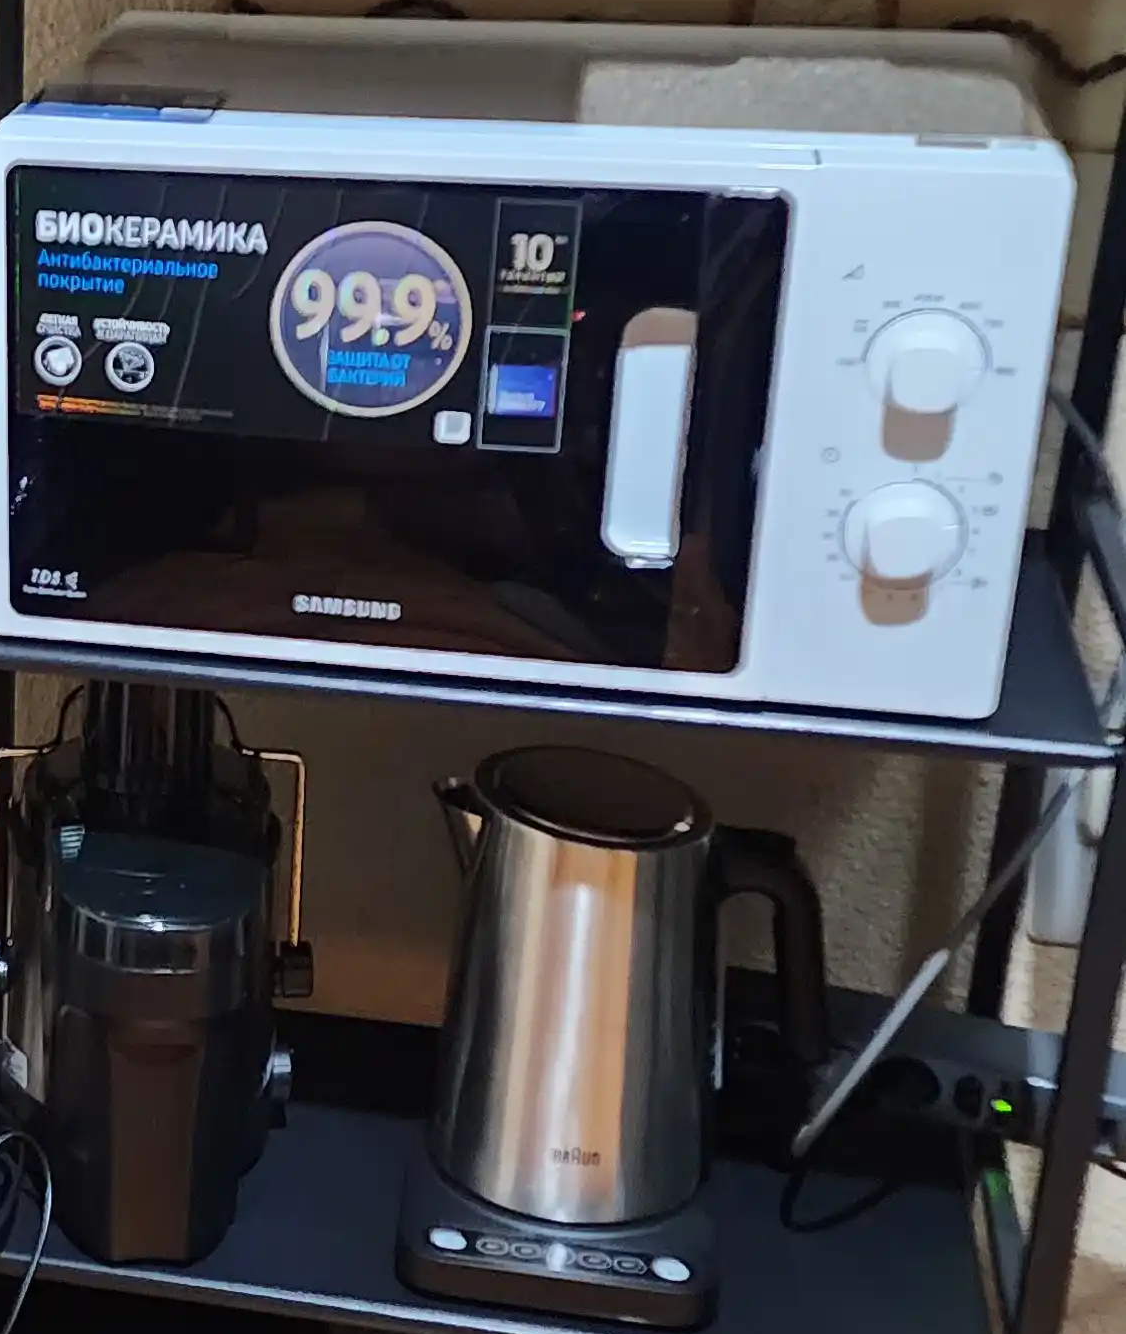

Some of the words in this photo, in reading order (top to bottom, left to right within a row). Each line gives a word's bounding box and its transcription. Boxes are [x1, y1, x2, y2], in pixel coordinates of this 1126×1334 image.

[35, 209, 269, 255] БИОКЕРАМИКА
[37, 249, 218, 279] Антибактериальное
[511, 233, 554, 271] 10
[37, 273, 125, 296] покрытие
[292, 593, 402, 621] SAMSUNG
